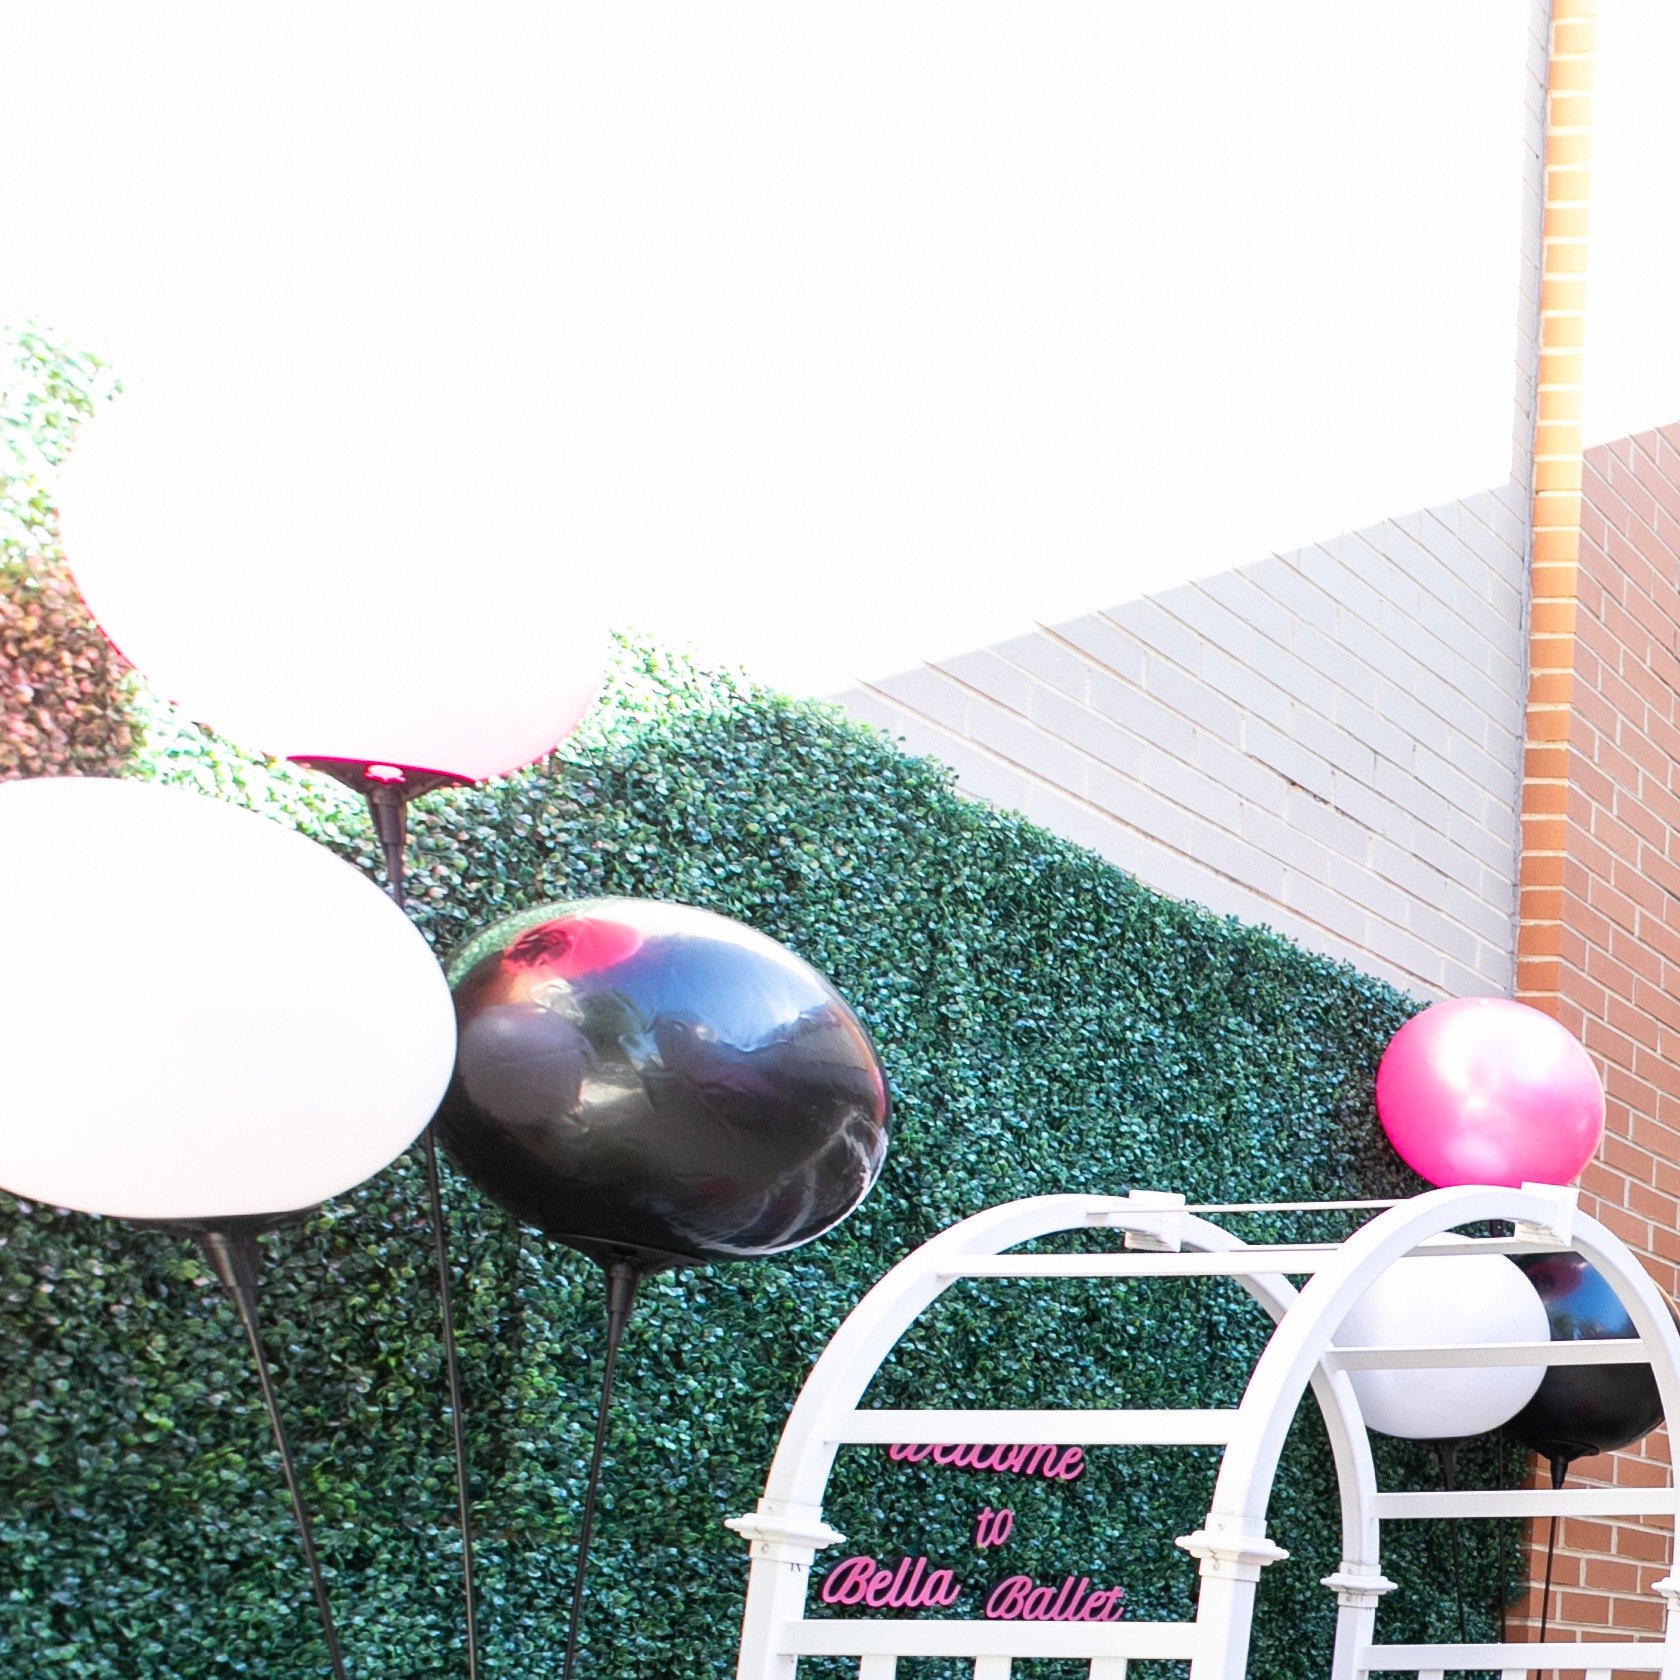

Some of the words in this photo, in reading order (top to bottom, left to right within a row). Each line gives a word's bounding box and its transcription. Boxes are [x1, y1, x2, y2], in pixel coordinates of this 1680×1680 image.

[976, 1506, 1013, 1549] to
[822, 1556, 961, 1608] Bella
[986, 1576, 1125, 1622] Ballet
